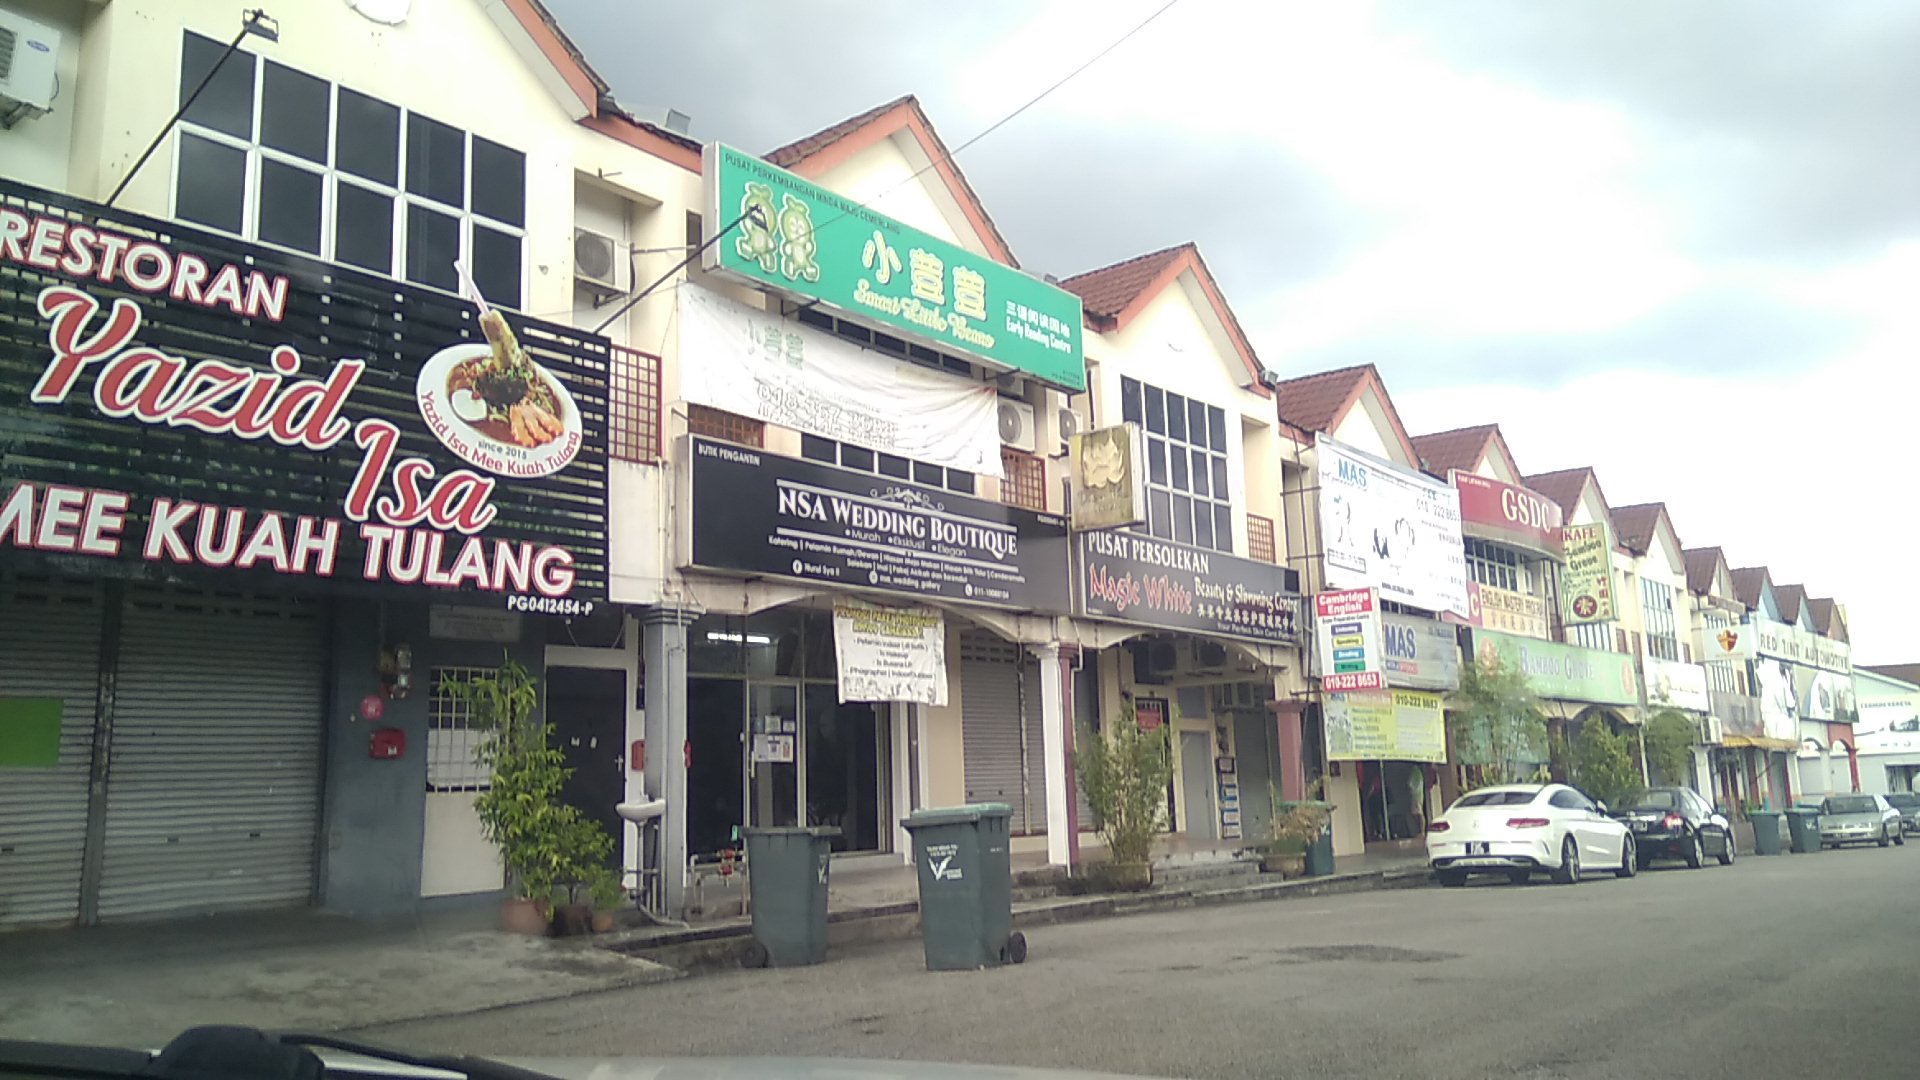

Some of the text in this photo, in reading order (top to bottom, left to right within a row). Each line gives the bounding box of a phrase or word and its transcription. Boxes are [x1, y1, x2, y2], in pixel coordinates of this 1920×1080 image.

[725, 152, 750, 172] PUSAT
[752, 166, 815, 199] PERKEMBANGAN
[0, 209, 289, 322] RESTORAN
[853, 278, 995, 349] Smart Little Beans
[1006, 315, 1072, 354] Early Reading Centre
[31, 286, 366, 449] Yazid
[420, 390, 580, 476] Yazid Isa Mee Kuah Tulang
[477, 440, 527, 460] since 2015
[698, 443, 761, 466] BUTIK PENGANTIN
[1338, 459, 1367, 487] MAS
[345, 417, 498, 536] Isa
[778, 486, 1018, 561] NSA WEDDING BOUTIQUE
[1501, 488, 1551, 533] GSDC
[143, 499, 341, 577] KUAH
[360, 523, 575, 597] TULANG
[851, 528, 881, 543] Murah
[937, 542, 967, 558] Elegan
[1088, 531, 1209, 575] PUSAT PERSOLEKAN
[1562, 528, 1597, 542] KAFE
[507, 595, 594, 616] PG0412454-P
[1089, 562, 1193, 615] Magic White
[1194, 576, 1225, 606] Beauty
[1319, 591, 1369, 606] Cambridge
[1327, 602, 1362, 615] English
[1385, 623, 1416, 659] MAS
[1760, 633, 1778, 651] RED
[1325, 674, 1356, 691] 010-222
